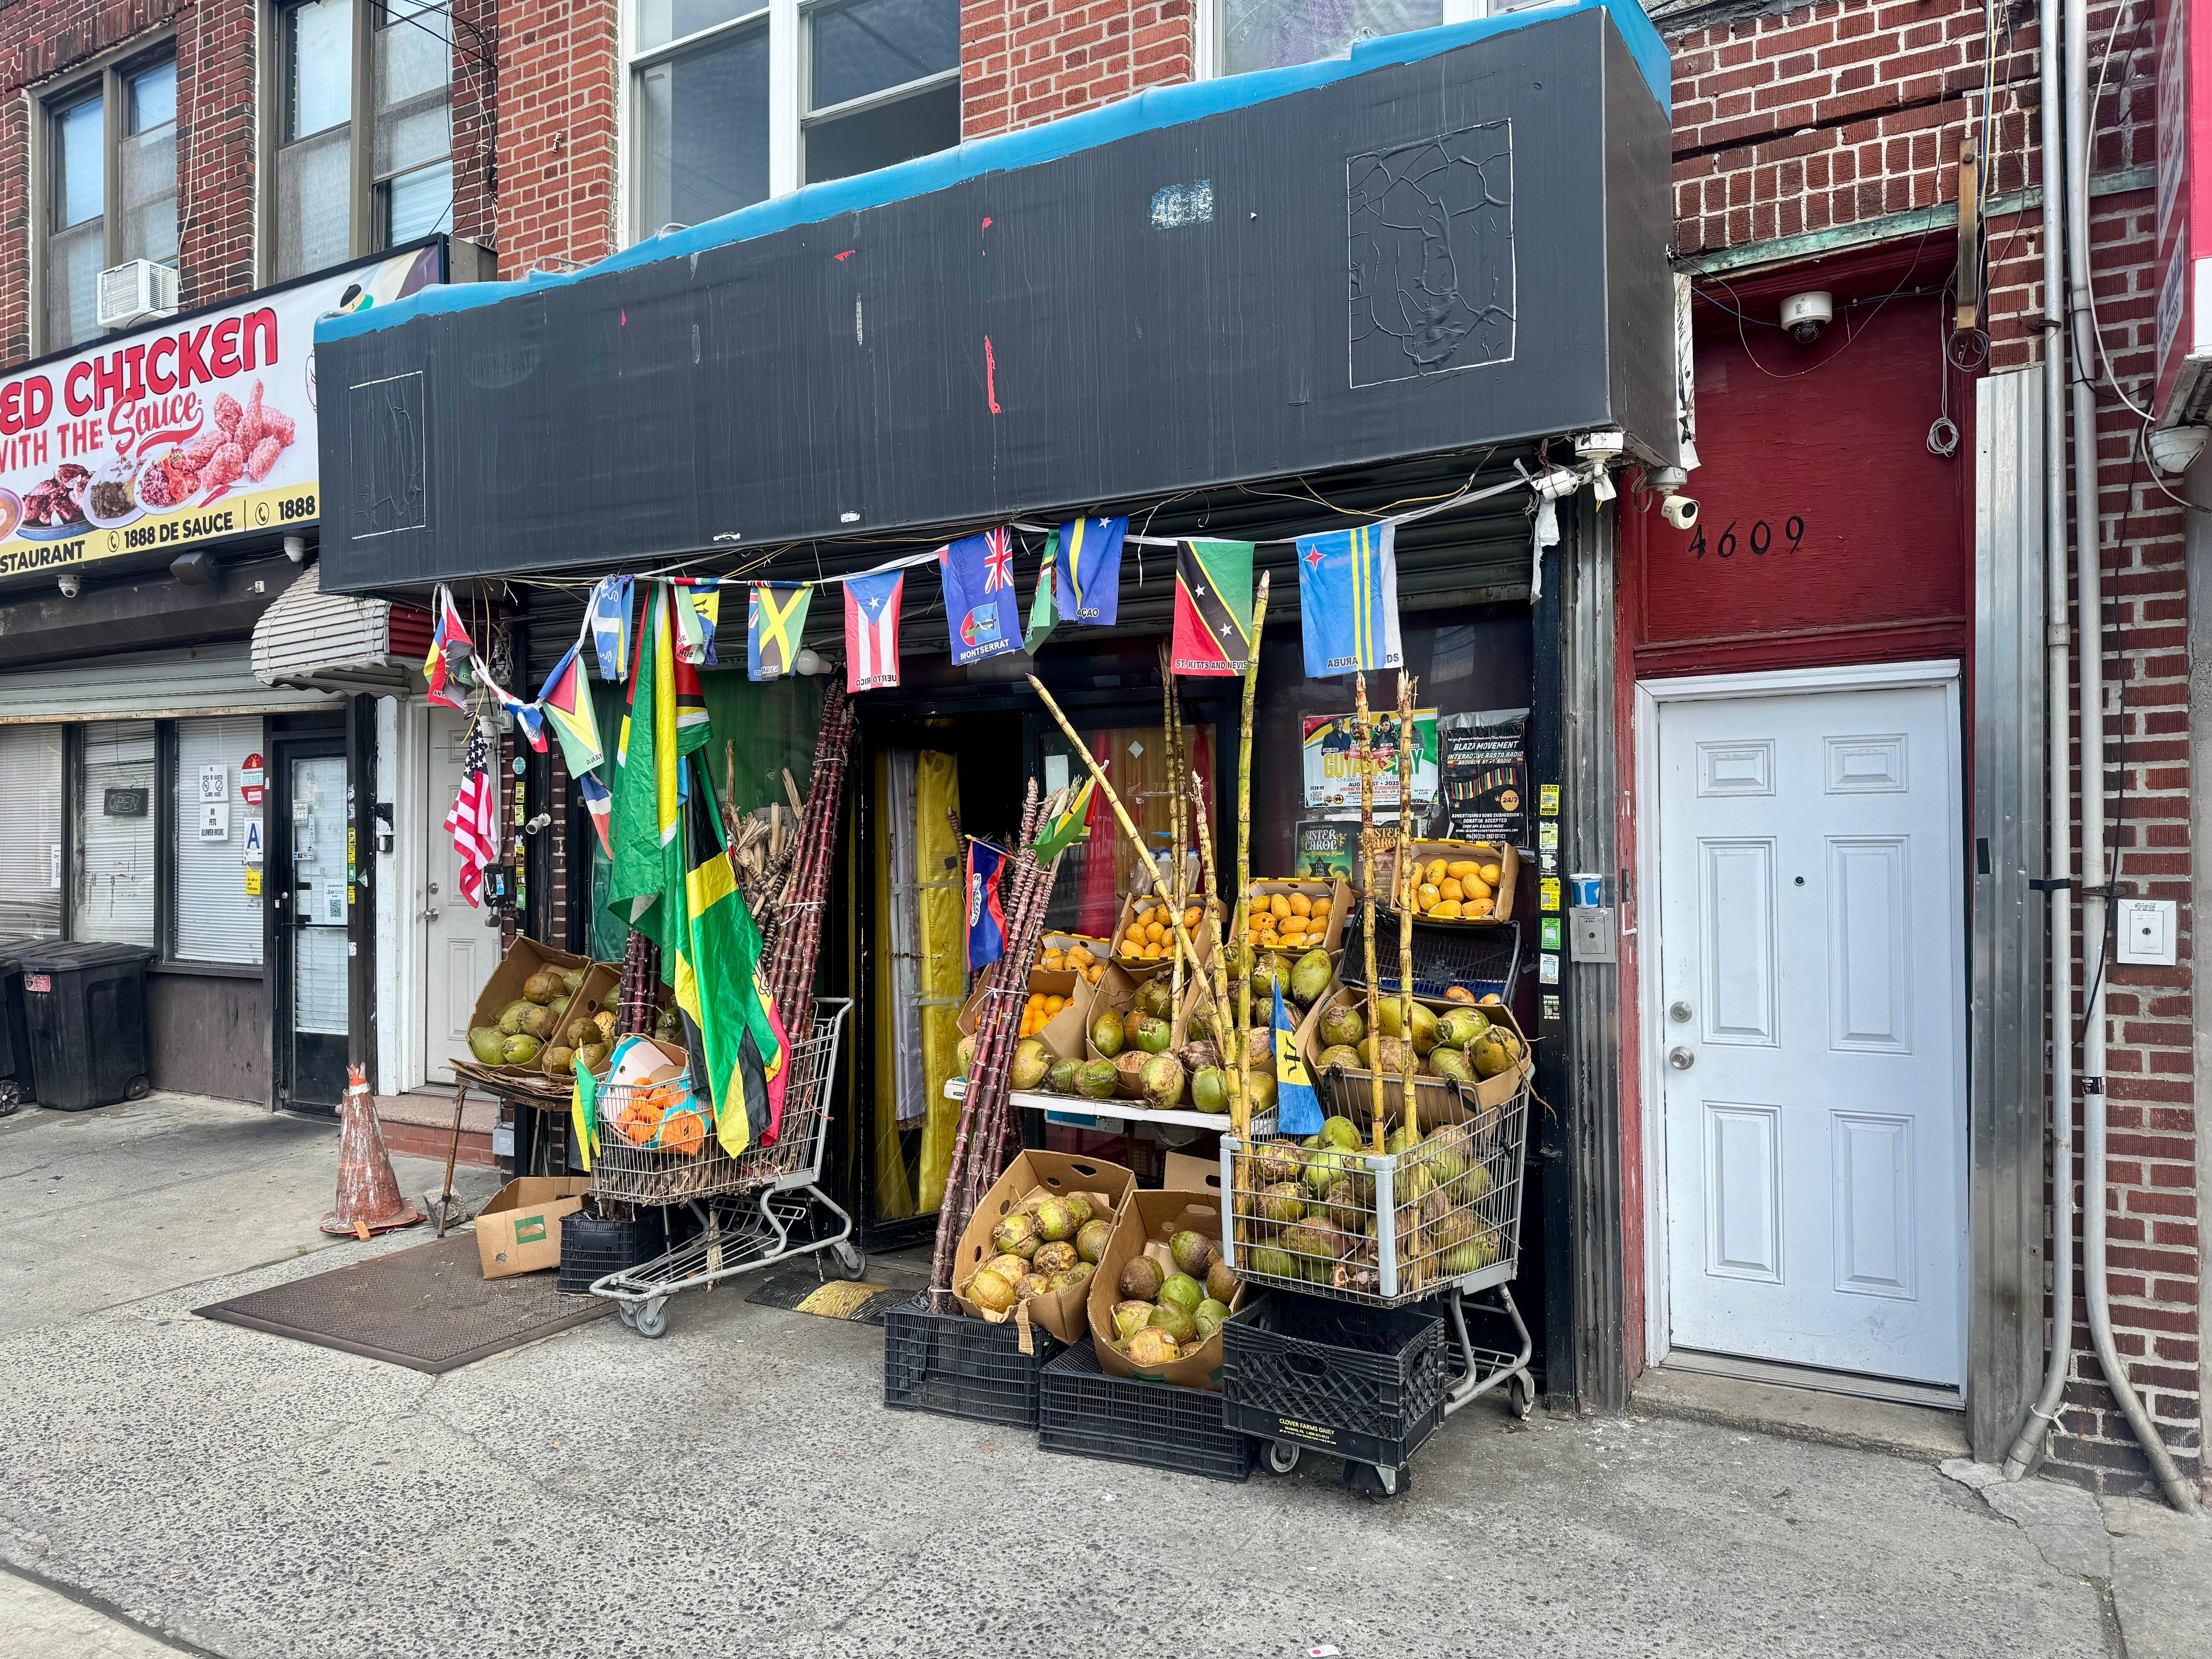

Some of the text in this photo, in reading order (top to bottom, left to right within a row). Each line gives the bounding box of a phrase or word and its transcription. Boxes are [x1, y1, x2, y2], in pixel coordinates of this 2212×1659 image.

[64, 307, 278, 417] CHICKEN
[57, 418, 104, 459] THE
[108, 391, 203, 458] Sauce
[0, 495, 316, 573] STAURANT 1888 DE SAUCE 1888
[1688, 516, 1805, 559] 4609
[960, 638, 1009, 661] MONTSERRAT
[1175, 660, 1248, 670] ST. KITTS AND NEVIS
[1476, 741, 1519, 750] MOVEMENT
[1323, 752, 1385, 778] GUYAA
[109, 795, 141, 810] OPEN
[247, 823, 260, 849] A
[1305, 829, 1336, 840] SISTER
[1305, 839, 1337, 850] CAROL
[1373, 838, 1396, 848] ARO
[1279, 1418, 1335, 1435] CLOVER FARMS DAIRY
